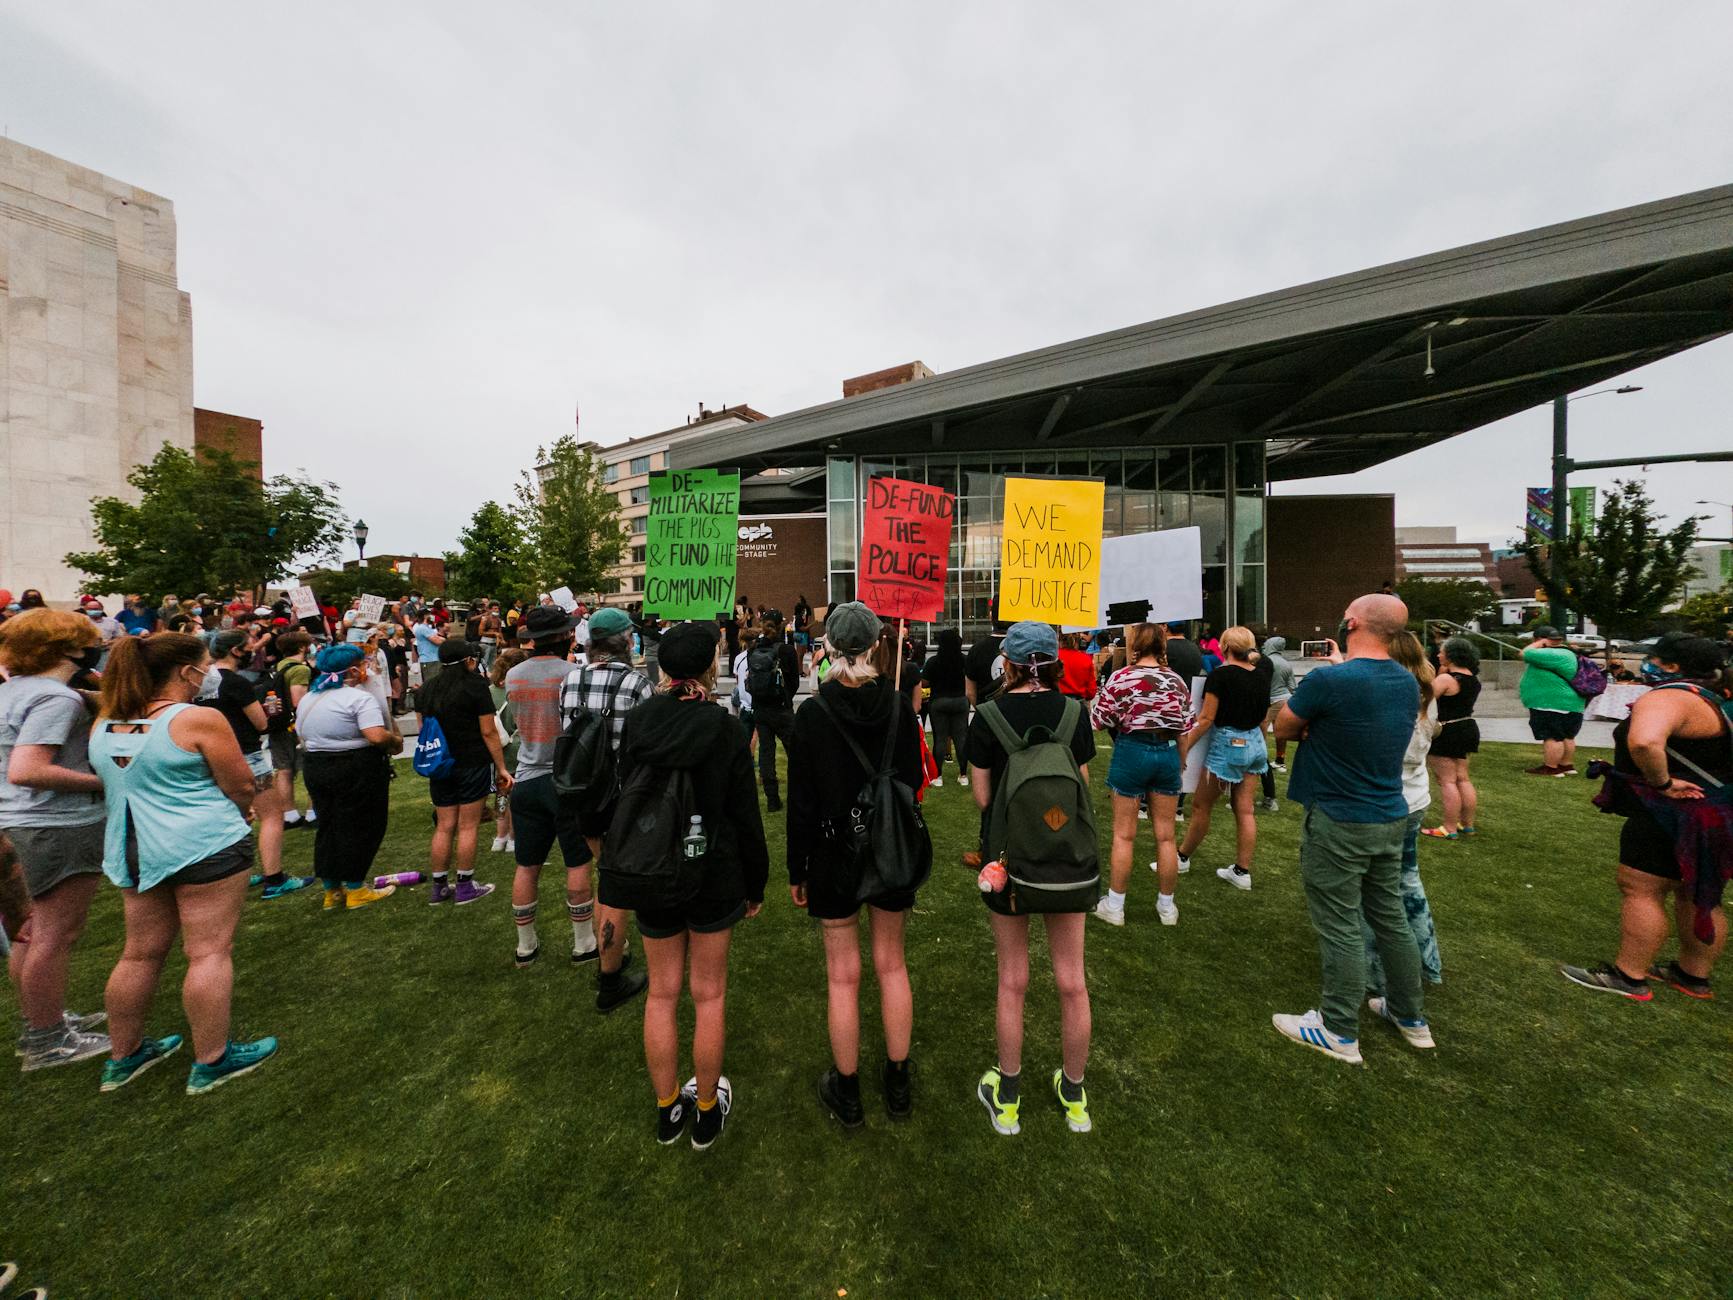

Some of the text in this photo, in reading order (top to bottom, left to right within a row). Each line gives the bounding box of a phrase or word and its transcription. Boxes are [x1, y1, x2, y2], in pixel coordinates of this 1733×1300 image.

[672, 473, 703, 493] DE-
[650, 492, 736, 515] MILITARIZE
[871, 481, 954, 518] DE-FUND
[658, 516, 721, 539] THE PIGS
[884, 516, 926, 544] THE
[1013, 502, 1067, 531] WE
[650, 543, 735, 567] & FUND THE
[868, 544, 940, 582] POLICE
[1007, 538, 1092, 571] DEMAND
[646, 575, 735, 609] COMMUNITY
[1009, 577, 1092, 612] JUSTICE
